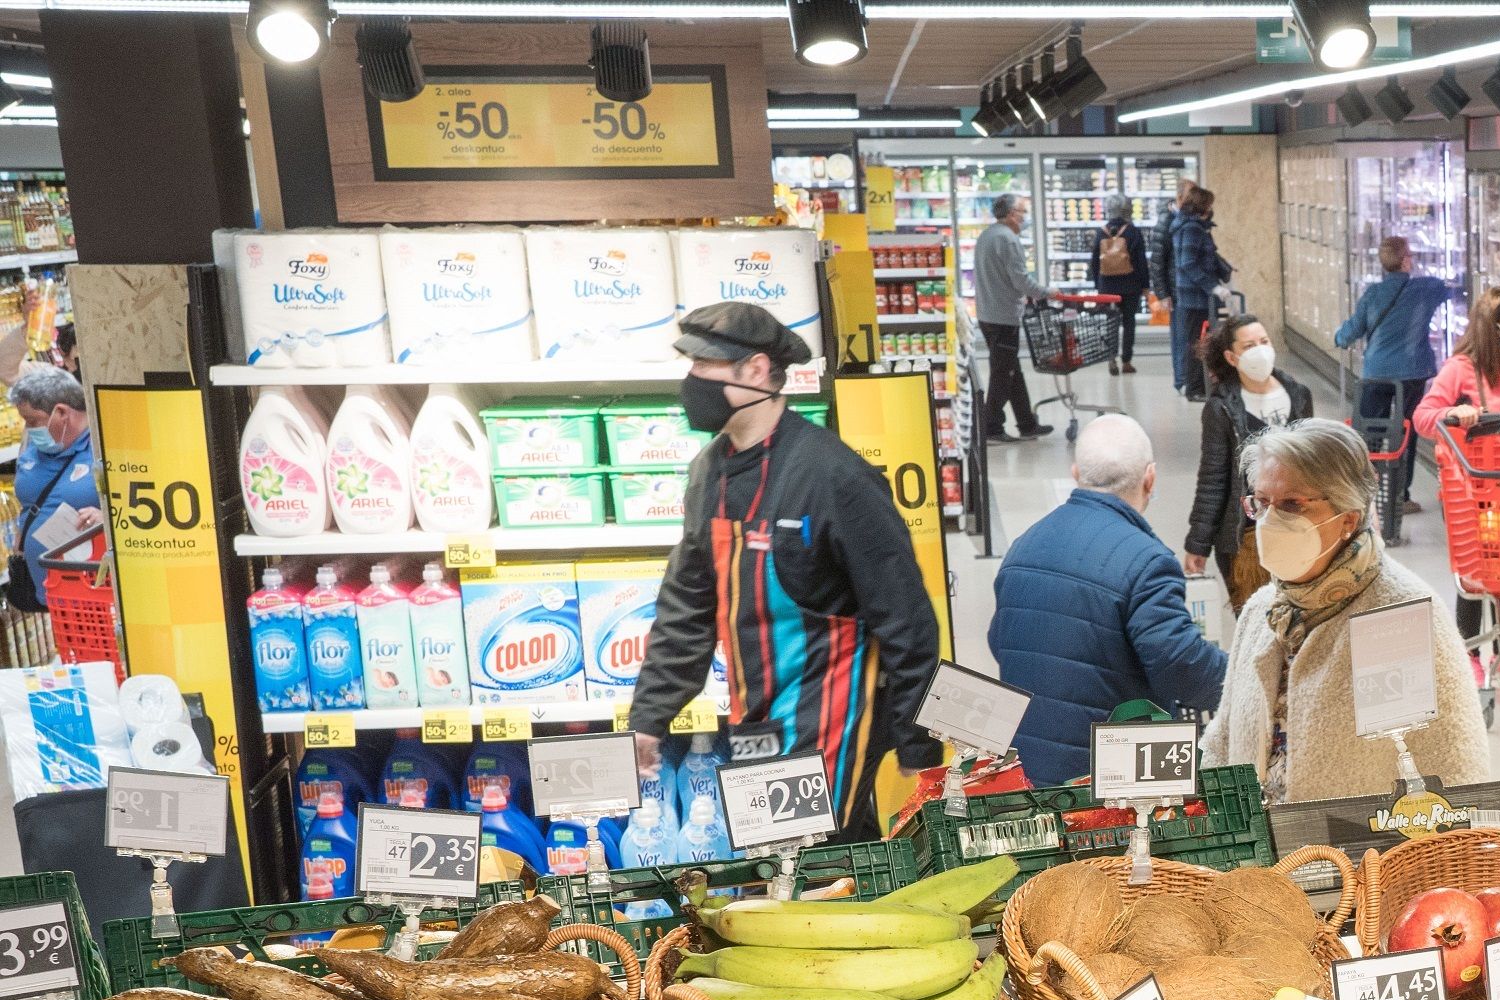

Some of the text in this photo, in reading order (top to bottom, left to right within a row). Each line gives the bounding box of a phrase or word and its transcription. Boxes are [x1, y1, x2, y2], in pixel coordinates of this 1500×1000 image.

[448, 87, 471, 97] alea
[451, 144, 505, 153] deskontua
[592, 144, 662, 153] de descuento
[868, 191, 893, 204] 2x1
[288, 259, 328, 278] Foxy
[438, 259, 474, 277] Foxy
[272, 283, 346, 304] UltraSoft
[422, 282, 492, 303] UltraSoft
[574, 280, 642, 300] UltraSoft
[720, 280, 788, 301] UltraSoft
[521, 452, 562, 463] ARIEL
[640, 450, 681, 461] ARIEL
[119, 463, 148, 473] alea
[265, 499, 308, 511] ARIEL
[351, 497, 394, 509] ARIEL
[433, 496, 475, 507] ARIEL
[530, 510, 571, 521] ARIEL
[124, 537, 196, 549] deskontua
[258, 640, 296, 662] flor
[311, 637, 350, 661] flor
[366, 639, 403, 660] flor
[421, 637, 456, 659] flor
[496, 632, 557, 673] COLON
[486, 726, 507, 738] 50%
[1139, 743, 1192, 780] 1,45
[726, 773, 748, 782] PLATANO
[764, 768, 786, 776] COCINAR
[1174, 765, 1182, 776] €
[690, 777, 713, 793] Ver
[749, 796, 767, 809] 46
[768, 775, 825, 821] 2,09
[811, 800, 820, 811] €
[1376, 808, 1429, 831] Valle de
[388, 846, 408, 859] 47
[410, 835, 476, 877] 2,35
[691, 849, 715, 863] Ver
[638, 853, 661, 867] Ver
[455, 864, 465, 876] €
[0, 924, 68, 976] 3,99
[48, 951, 60, 966] €
